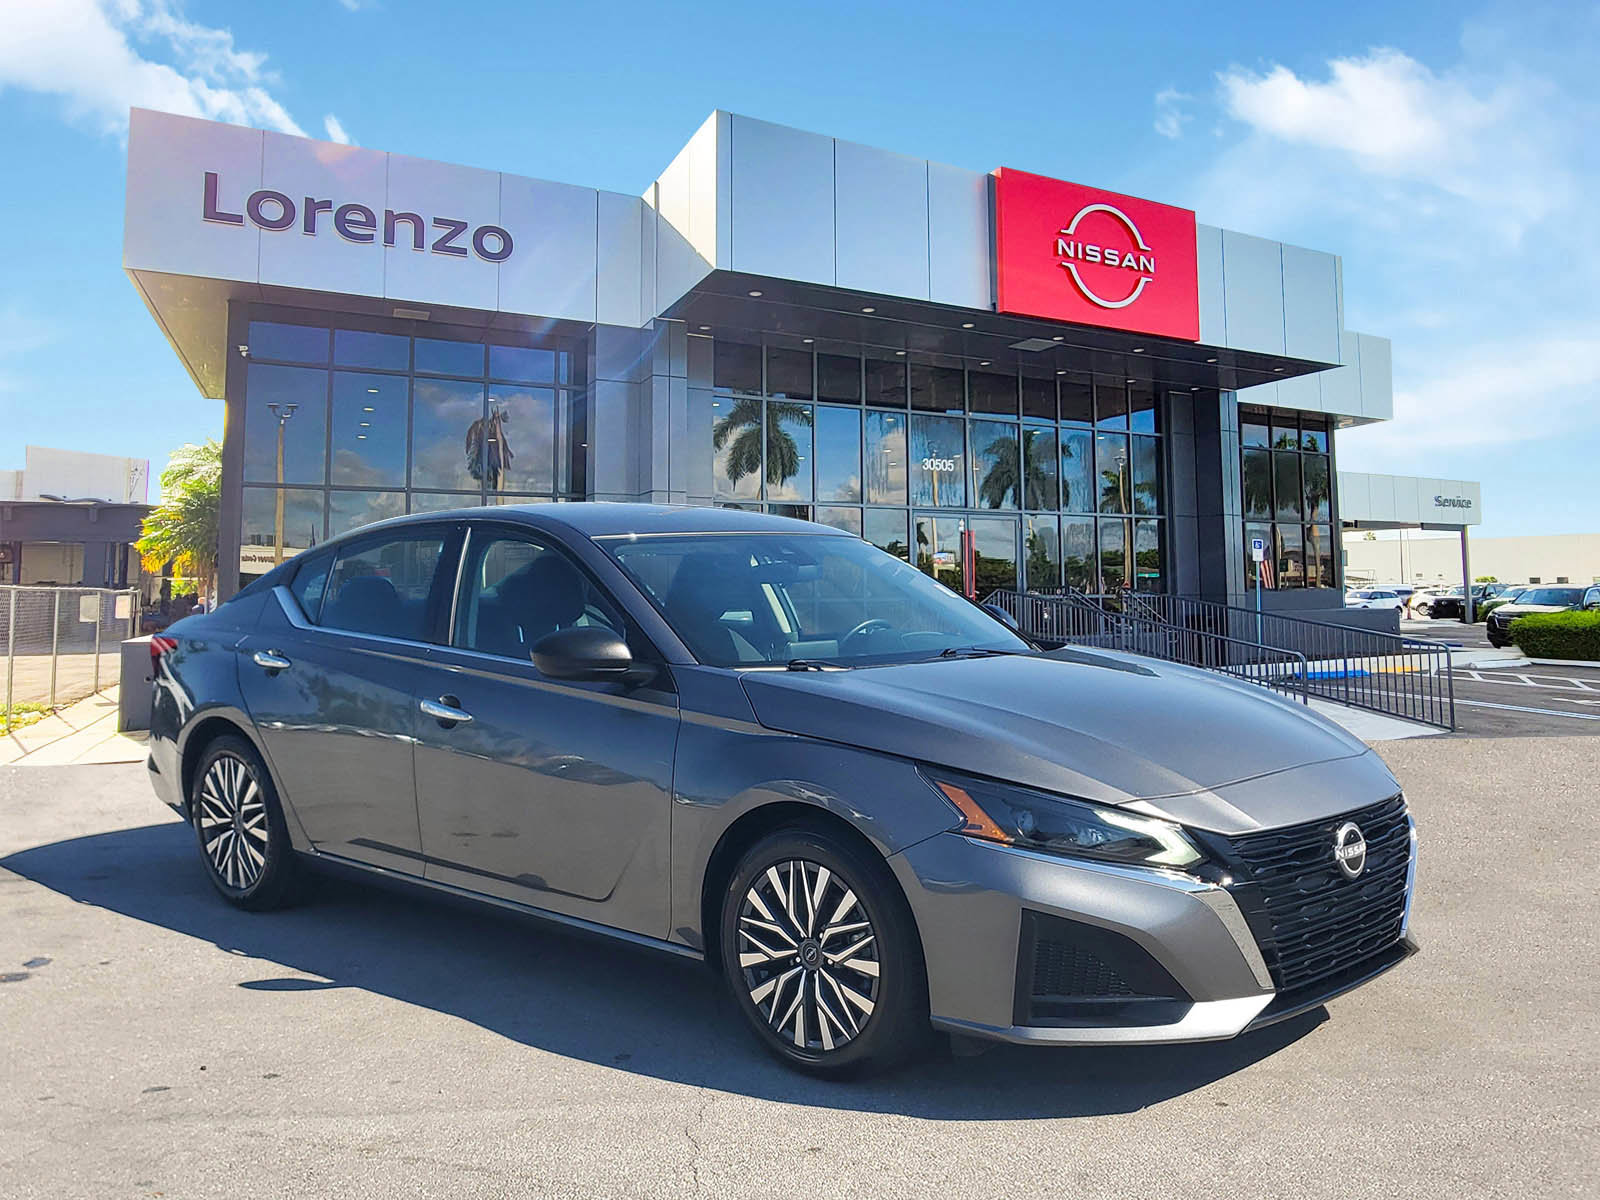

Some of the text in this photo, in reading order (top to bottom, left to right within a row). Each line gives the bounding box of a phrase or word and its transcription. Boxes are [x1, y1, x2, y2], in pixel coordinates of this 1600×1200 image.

[203, 171, 514, 262] Lorenzo
[1057, 238, 1155, 273] NISSAN
[922, 458, 954, 471] 30505
[1434, 496, 1472, 508] Service
[1335, 843, 1366, 860] NISS
